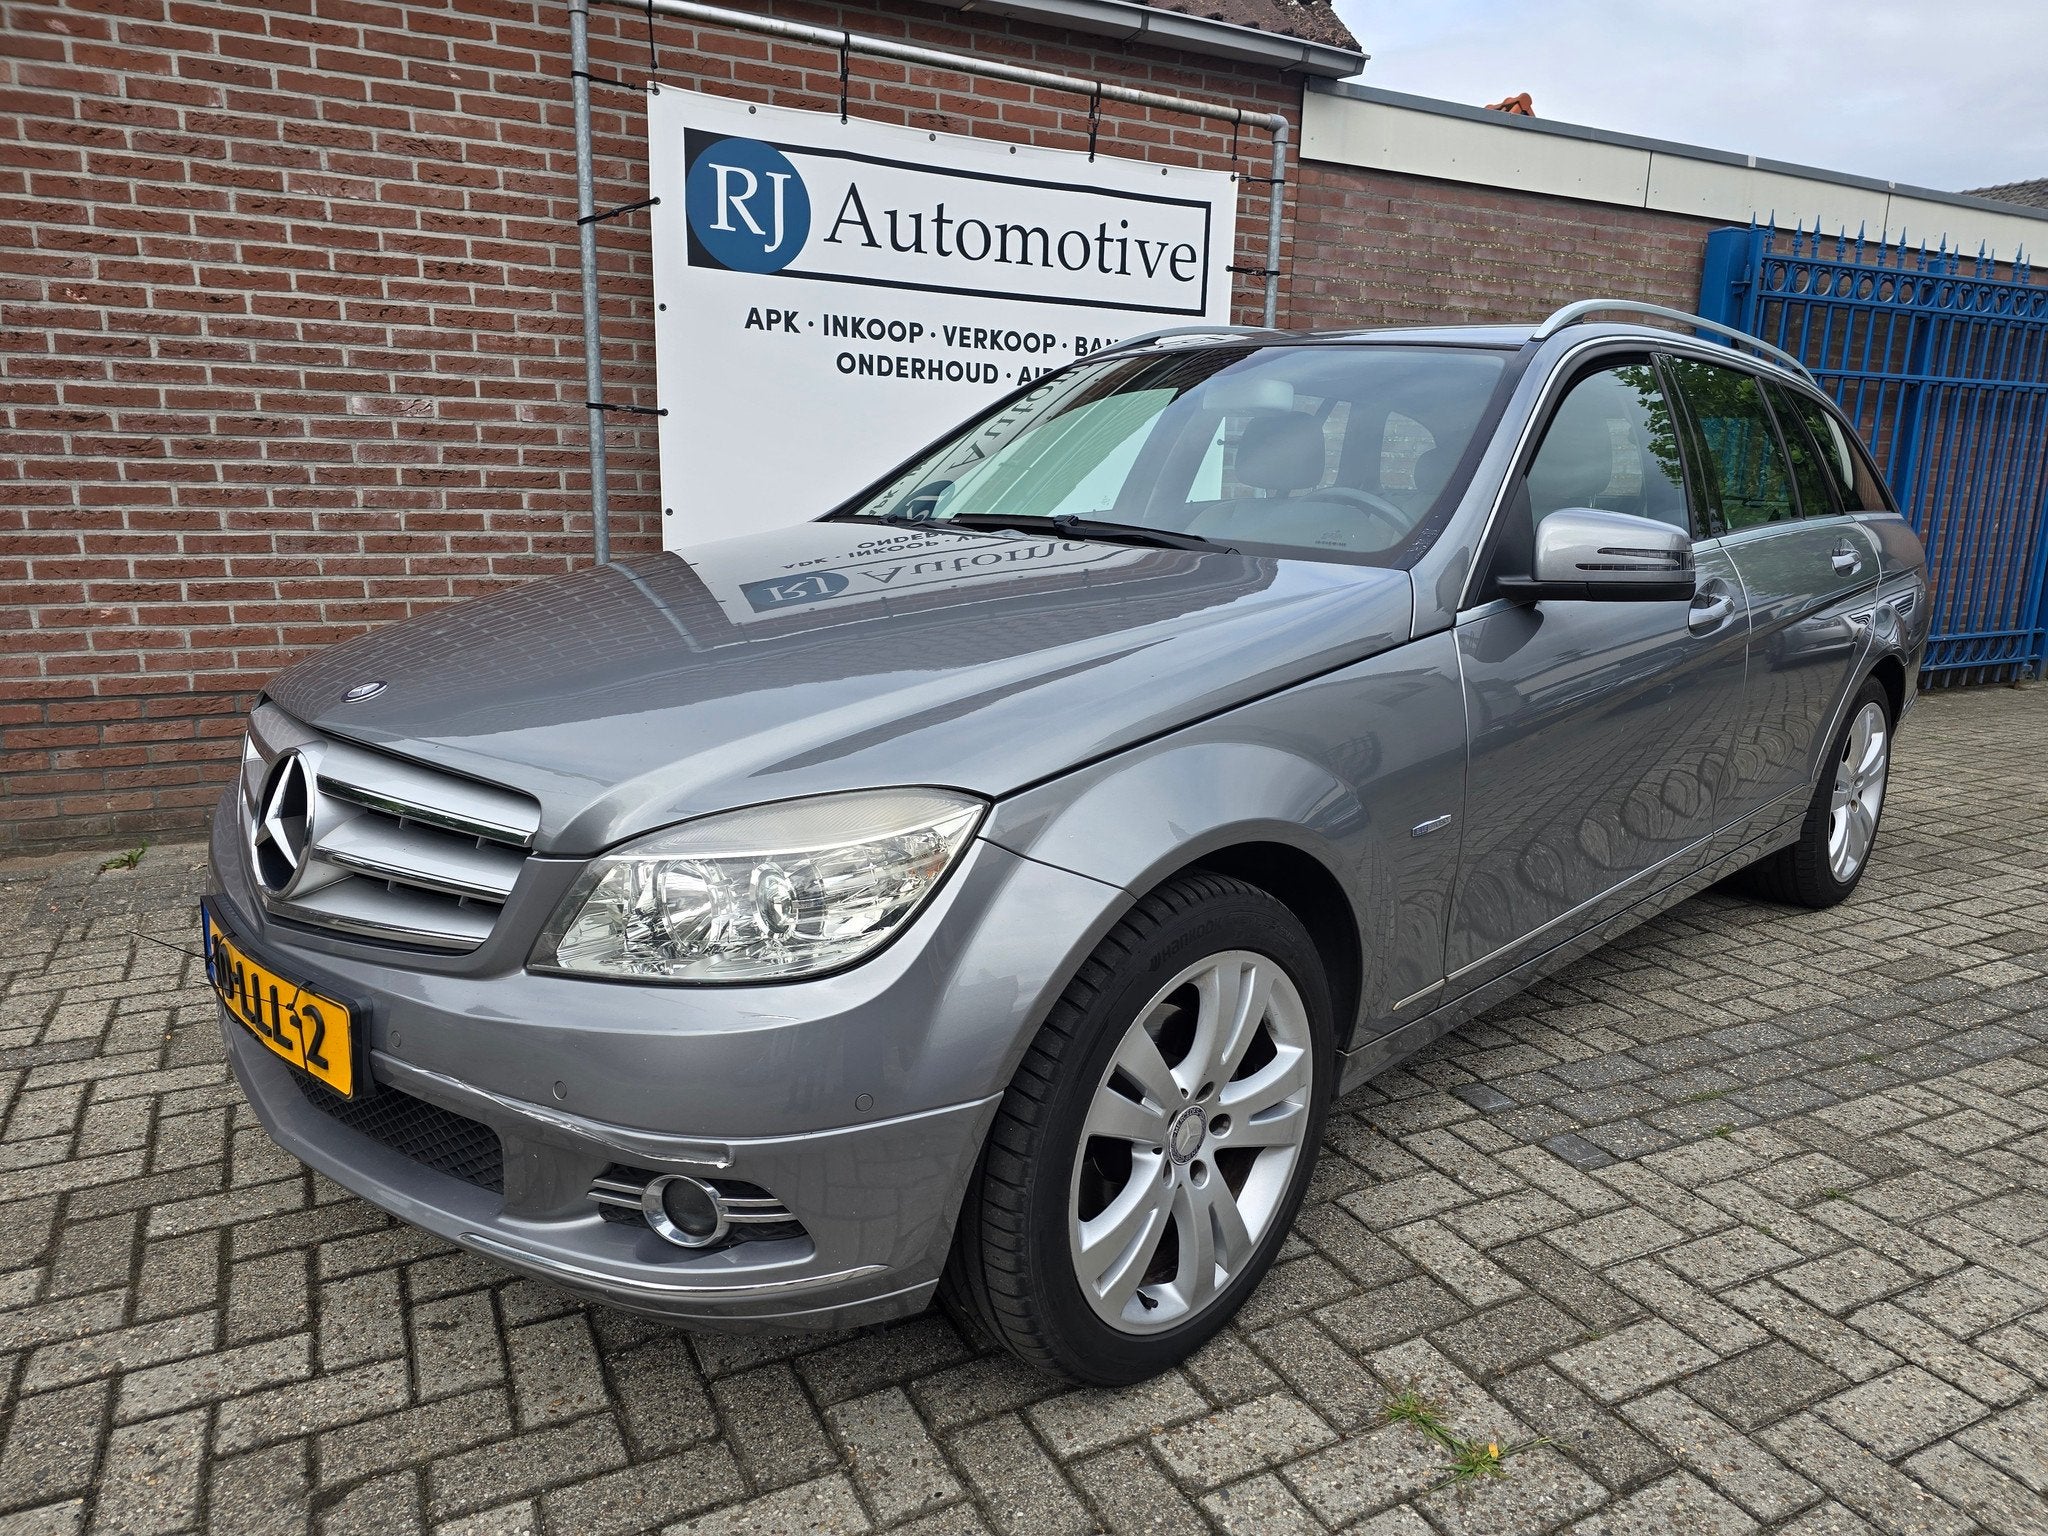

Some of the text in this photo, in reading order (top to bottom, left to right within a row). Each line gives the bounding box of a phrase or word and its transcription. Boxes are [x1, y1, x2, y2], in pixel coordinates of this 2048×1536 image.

[708, 162, 1197, 282] RJ Automotive
[744, 306, 801, 334] APK
[823, 313, 924, 344] INKOOP
[942, 324, 1056, 354] VERKOOP
[836, 351, 999, 384] ONDERHOUD
